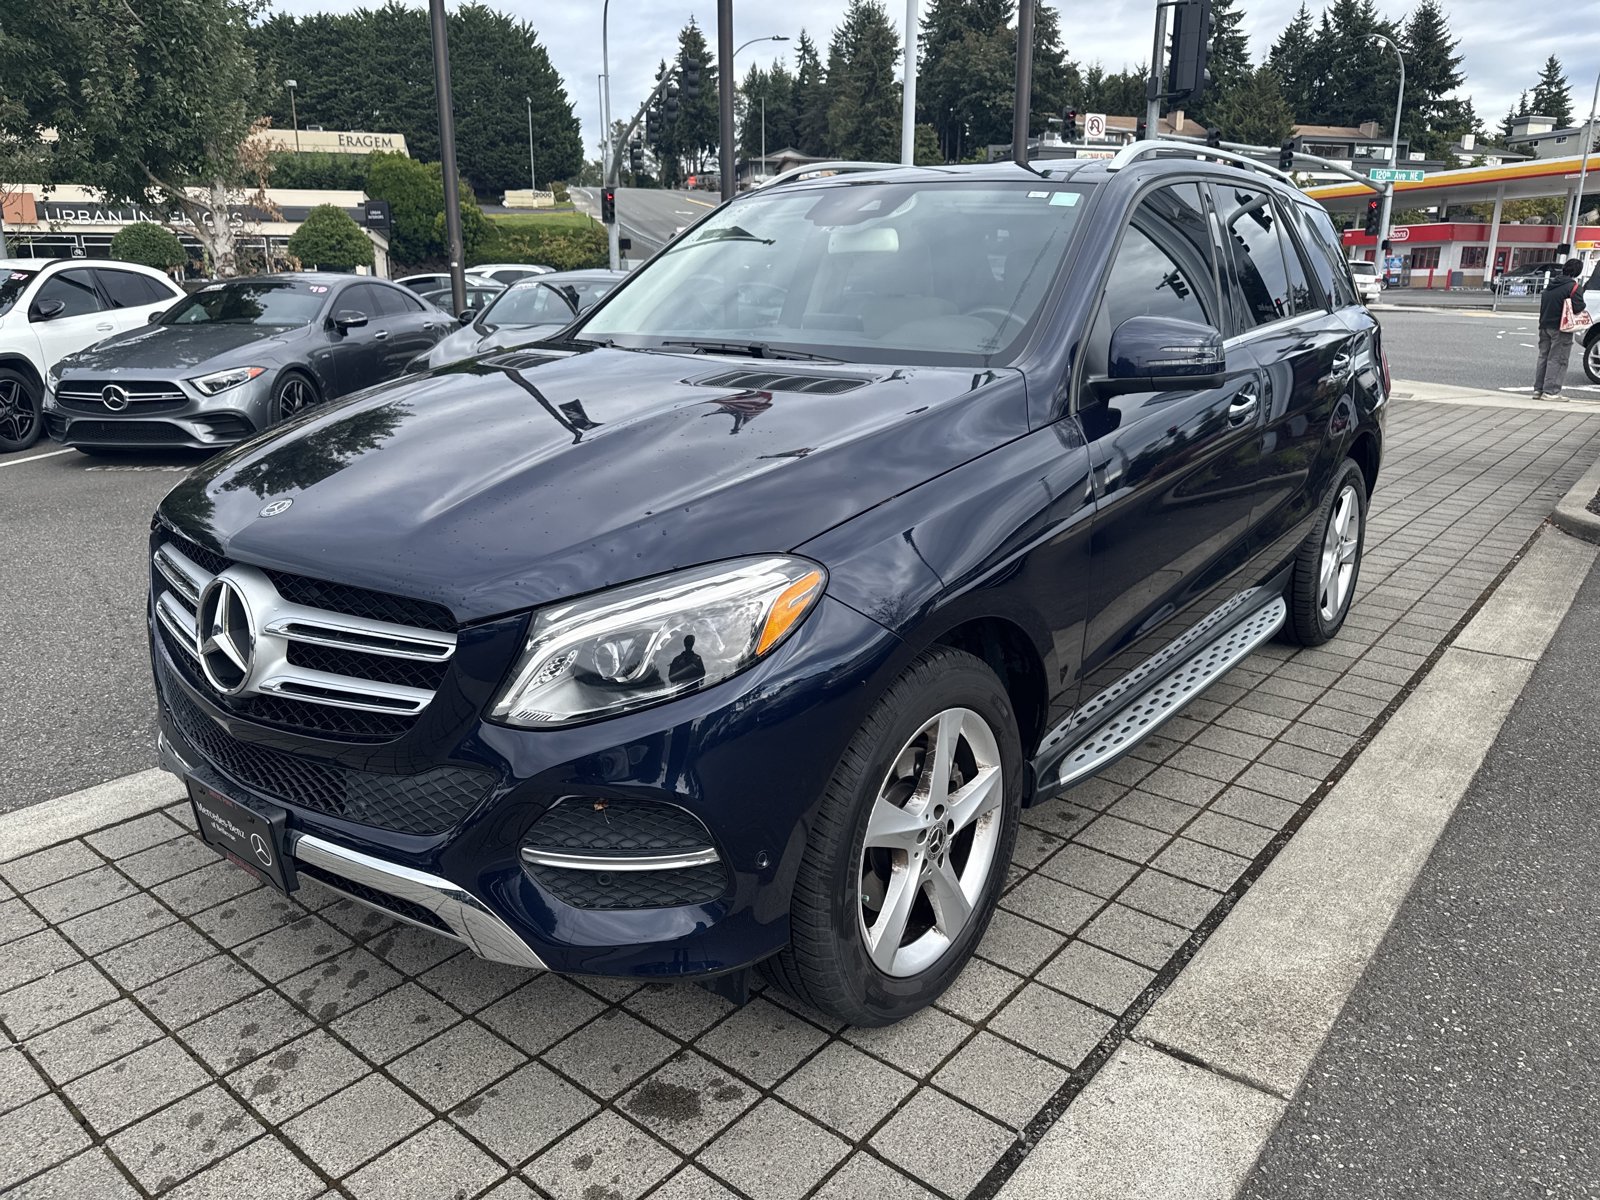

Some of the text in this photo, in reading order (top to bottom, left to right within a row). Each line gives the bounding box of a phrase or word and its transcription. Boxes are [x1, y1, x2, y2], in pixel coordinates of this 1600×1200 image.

[1376, 170, 1419, 181] 120th Ave NE
[44, 207, 123, 226] URBAN
